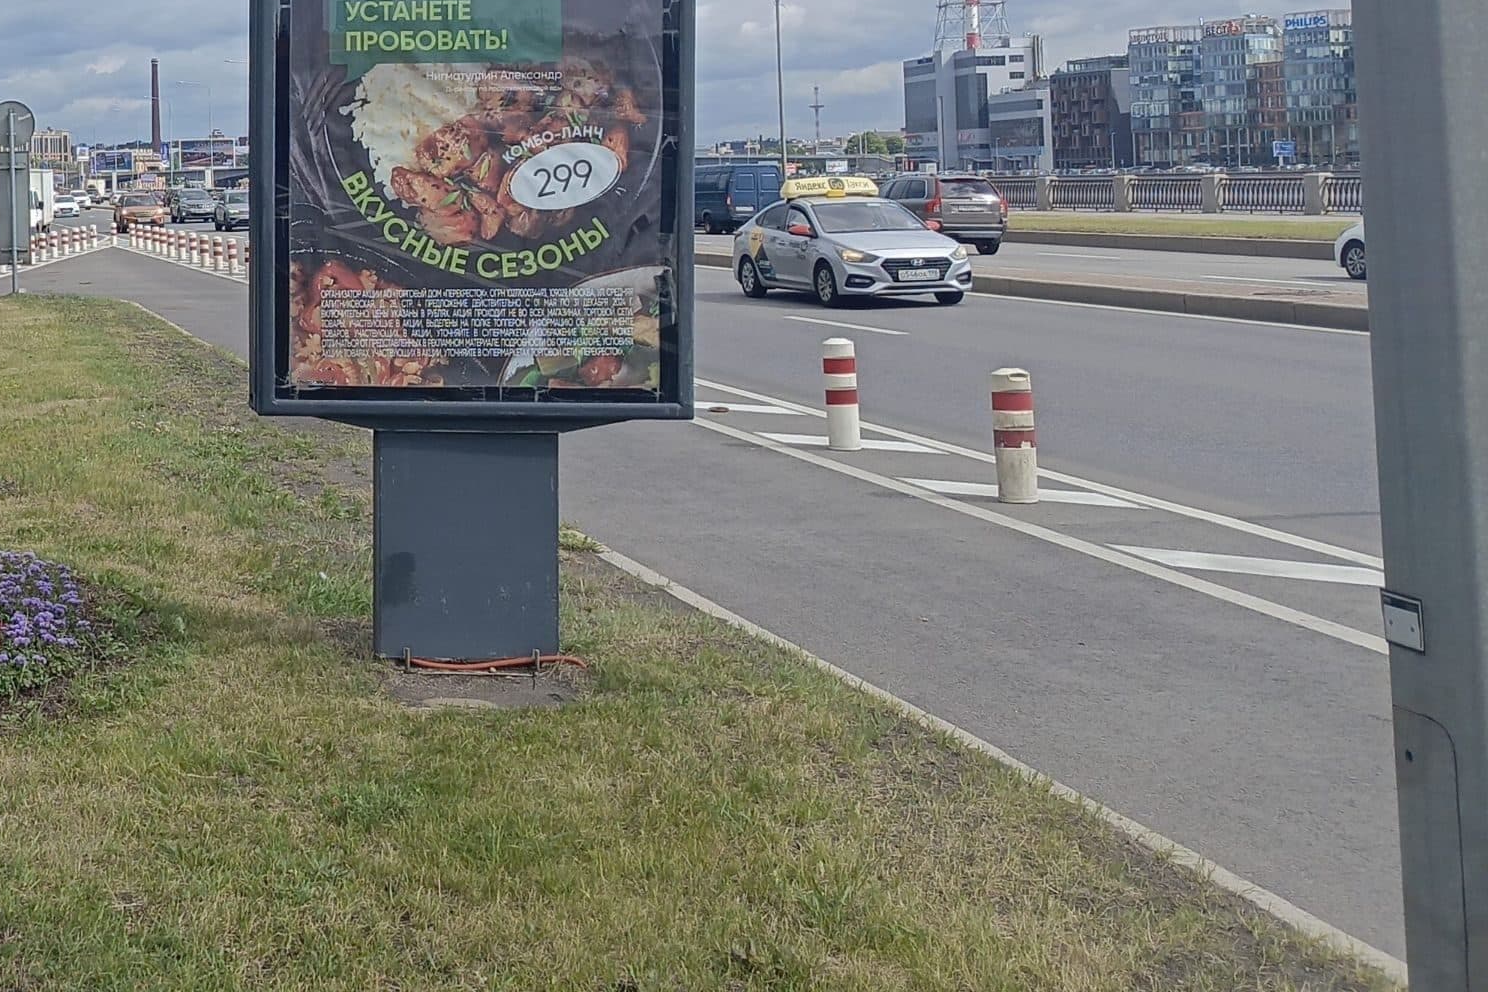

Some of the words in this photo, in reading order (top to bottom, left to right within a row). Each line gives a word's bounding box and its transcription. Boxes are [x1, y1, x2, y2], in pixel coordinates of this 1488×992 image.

[345, 0, 472, 22] УСТАНЕТЕ
[1285, 15, 1326, 28] PHILIPS
[345, 29, 508, 51] ПРОБОВАТЬ!
[426, 72, 497, 83] Нигматуллин
[500, 70, 562, 83] Александр
[502, 126, 604, 164] КОМБО-ЛАНЧ
[533, 159, 592, 197] 299
[795, 182, 827, 190] Яндекс
[343, 171, 470, 275] ВКУСНЫЕ
[477, 217, 610, 279] СЕЗОНЫ
